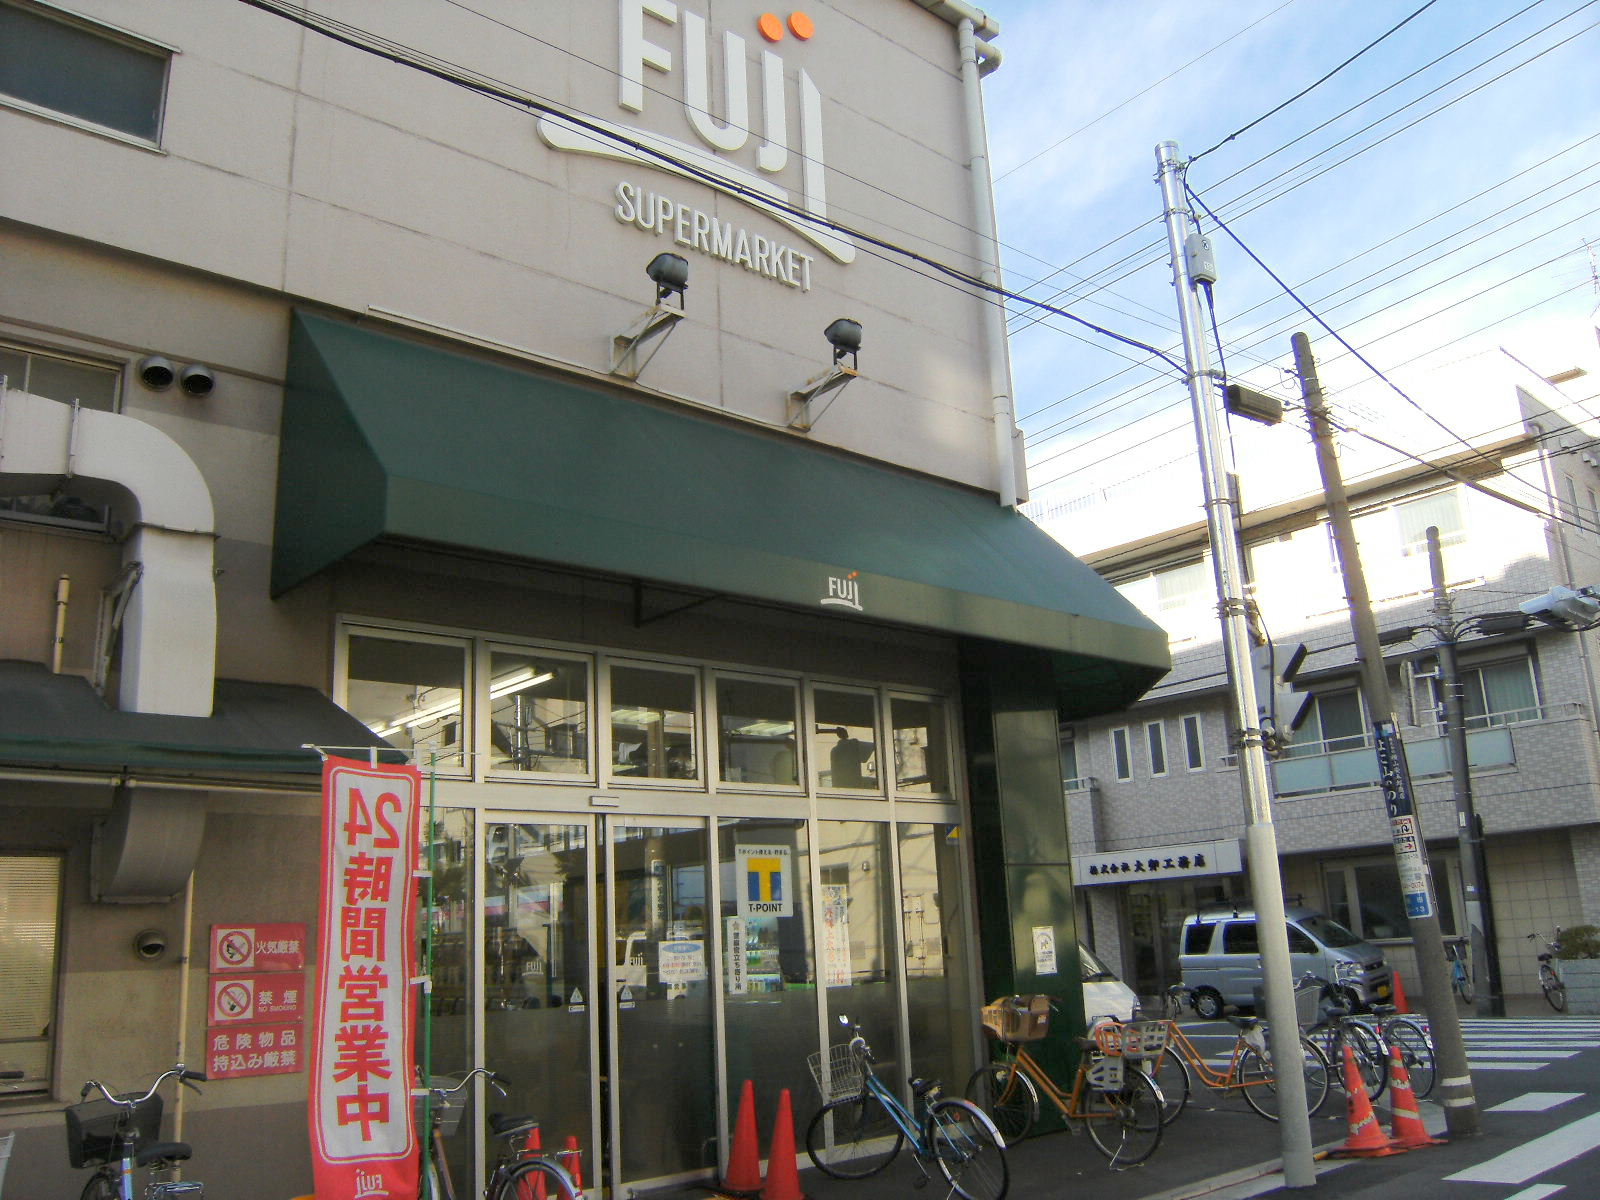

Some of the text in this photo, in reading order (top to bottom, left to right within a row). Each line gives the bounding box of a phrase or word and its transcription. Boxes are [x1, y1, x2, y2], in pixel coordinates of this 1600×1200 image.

[613, 180, 815, 293] SUPERMARKET
[255, 940, 300, 955] 火気厳禁
[270, 1004, 297, 1012] SMOKING
[213, 1030, 296, 1051] 危険物品
[213, 1050, 296, 1072] 持込み厳禁
